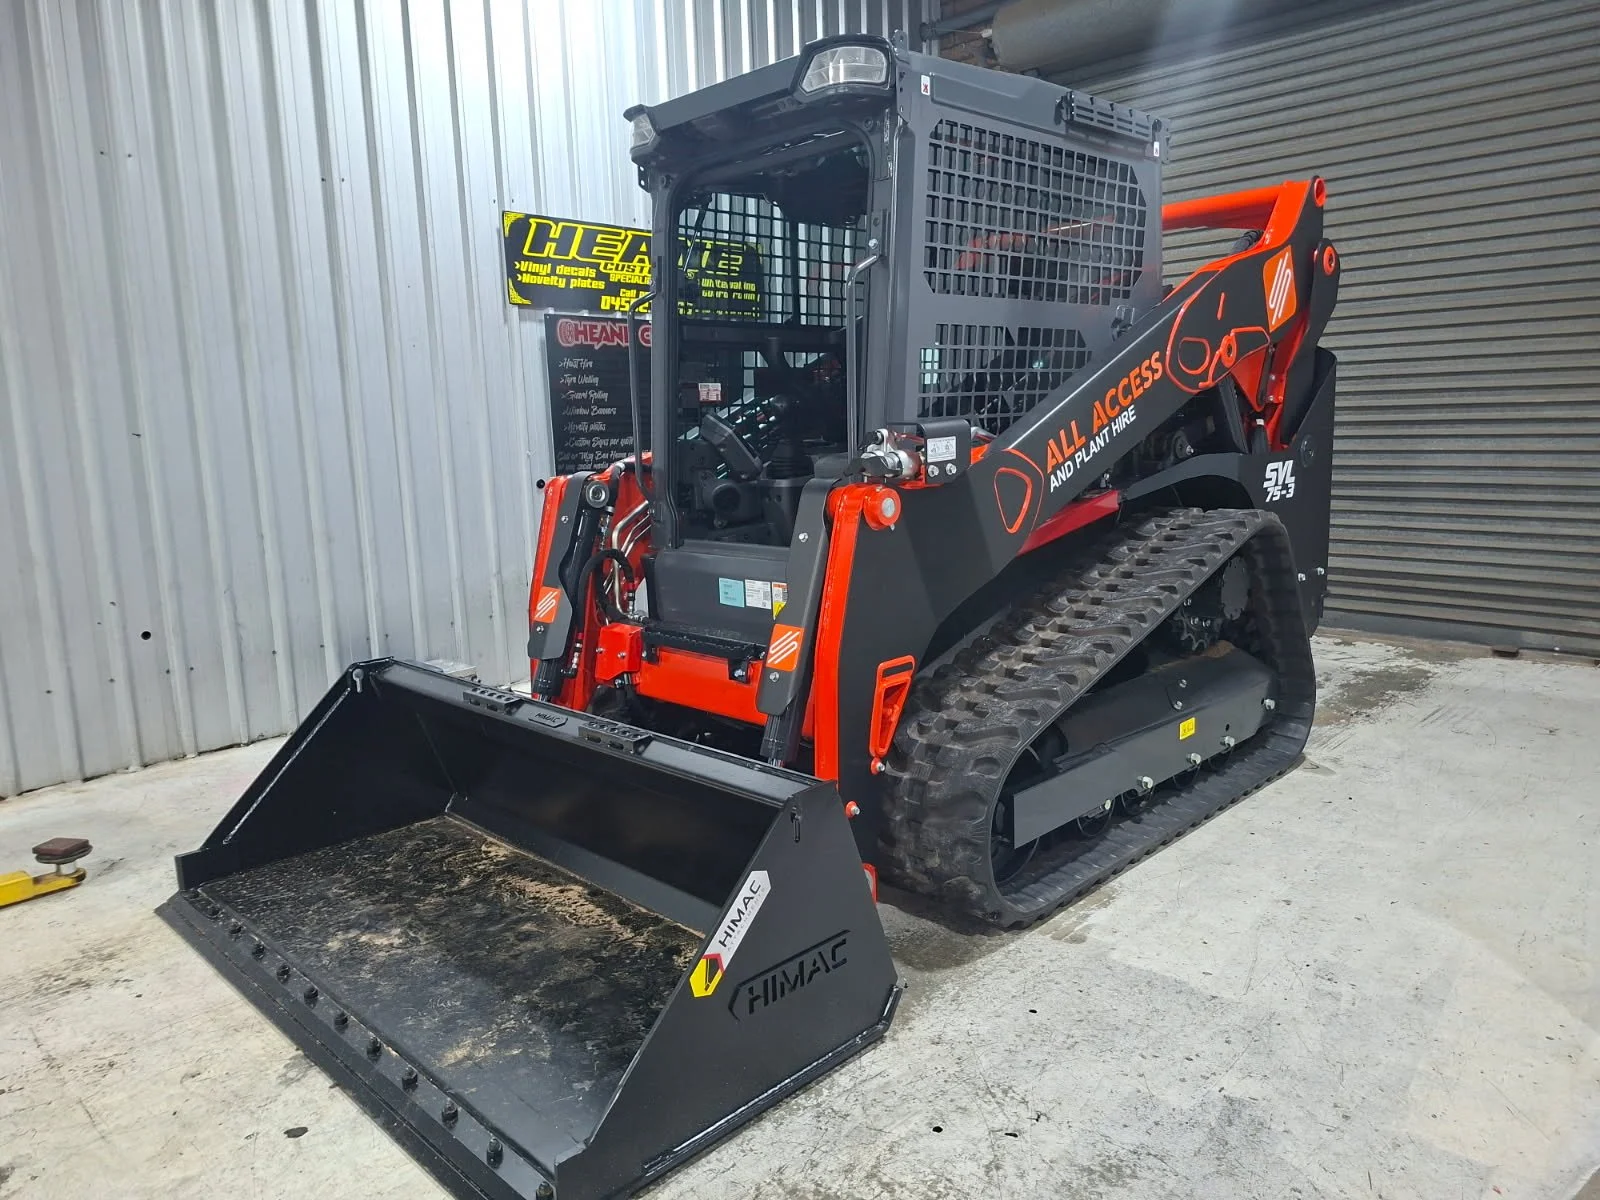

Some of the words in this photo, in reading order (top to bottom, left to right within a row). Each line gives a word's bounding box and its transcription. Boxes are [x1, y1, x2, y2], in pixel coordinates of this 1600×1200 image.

[520, 260, 551, 276] Vinyl
[556, 264, 597, 278] decals
[522, 274, 566, 288] Novelty
[570, 277, 606, 290] plates
[619, 288, 637, 298] Call
[1046, 420, 1087, 474] ALL
[1092, 350, 1163, 434] ACCESS
[1050, 460, 1074, 493] AND
[1074, 427, 1110, 469] PLANT
[1111, 405, 1137, 437] HIRE
[1263, 460, 1295, 488] SVL
[1265, 483, 1295, 502] 75-3
[718, 879, 761, 948] HIMAC
[748, 938, 848, 1015] HIMAC
